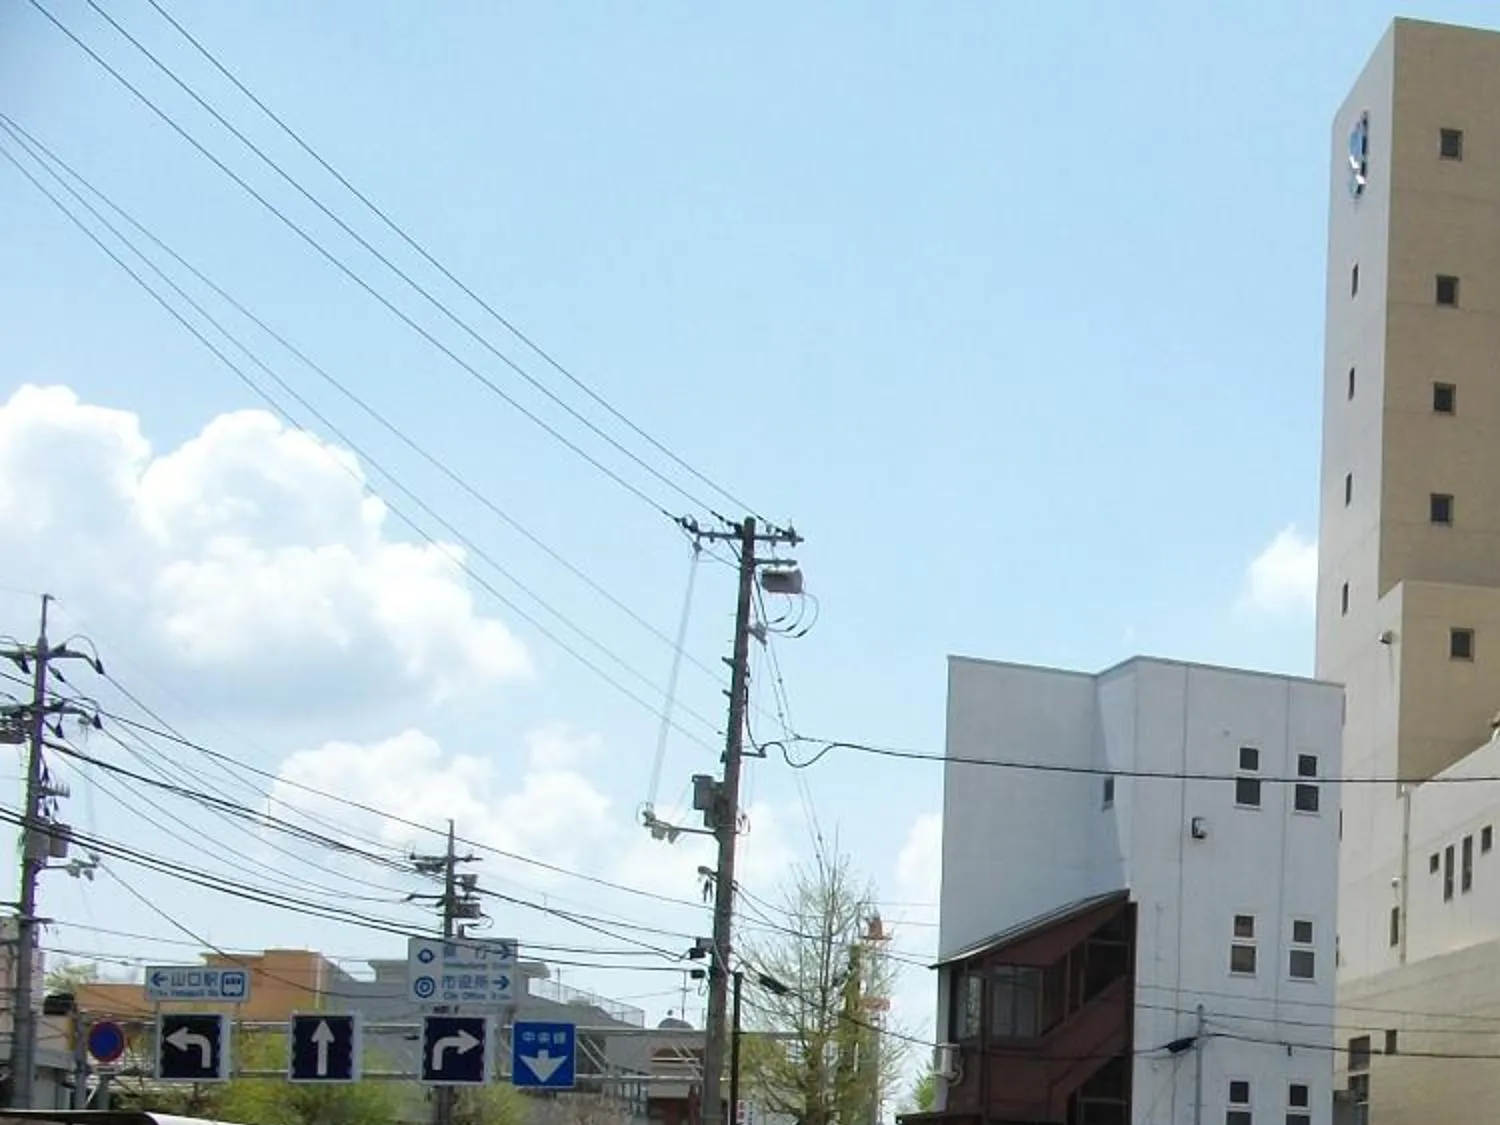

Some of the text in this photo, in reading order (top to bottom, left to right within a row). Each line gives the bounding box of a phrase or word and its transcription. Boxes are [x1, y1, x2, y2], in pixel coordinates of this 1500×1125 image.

[171, 971, 219, 987] 山口駅
[442, 974, 489, 989] 市役所
